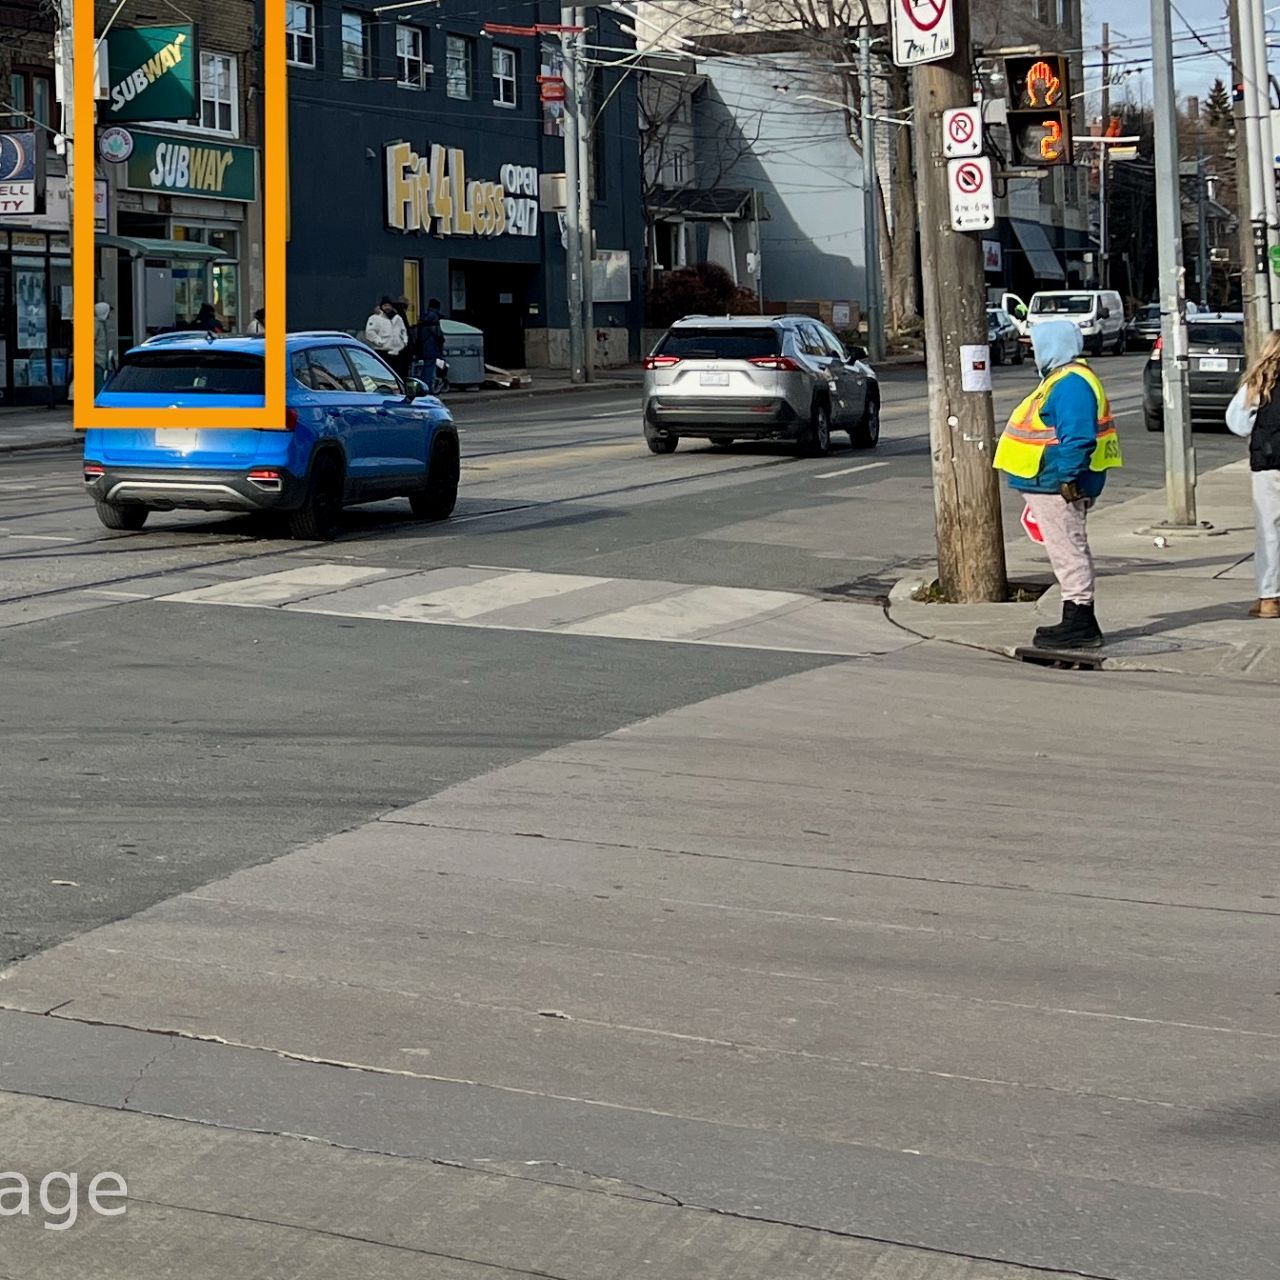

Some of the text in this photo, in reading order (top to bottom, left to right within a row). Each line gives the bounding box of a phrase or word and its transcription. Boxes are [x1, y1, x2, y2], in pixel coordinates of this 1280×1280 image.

[111, 33, 186, 112] SUBWAY
[1041, 120, 1062, 158] 2
[149, 141, 234, 193] SUBWAY
[500, 163, 538, 197] OPEN
